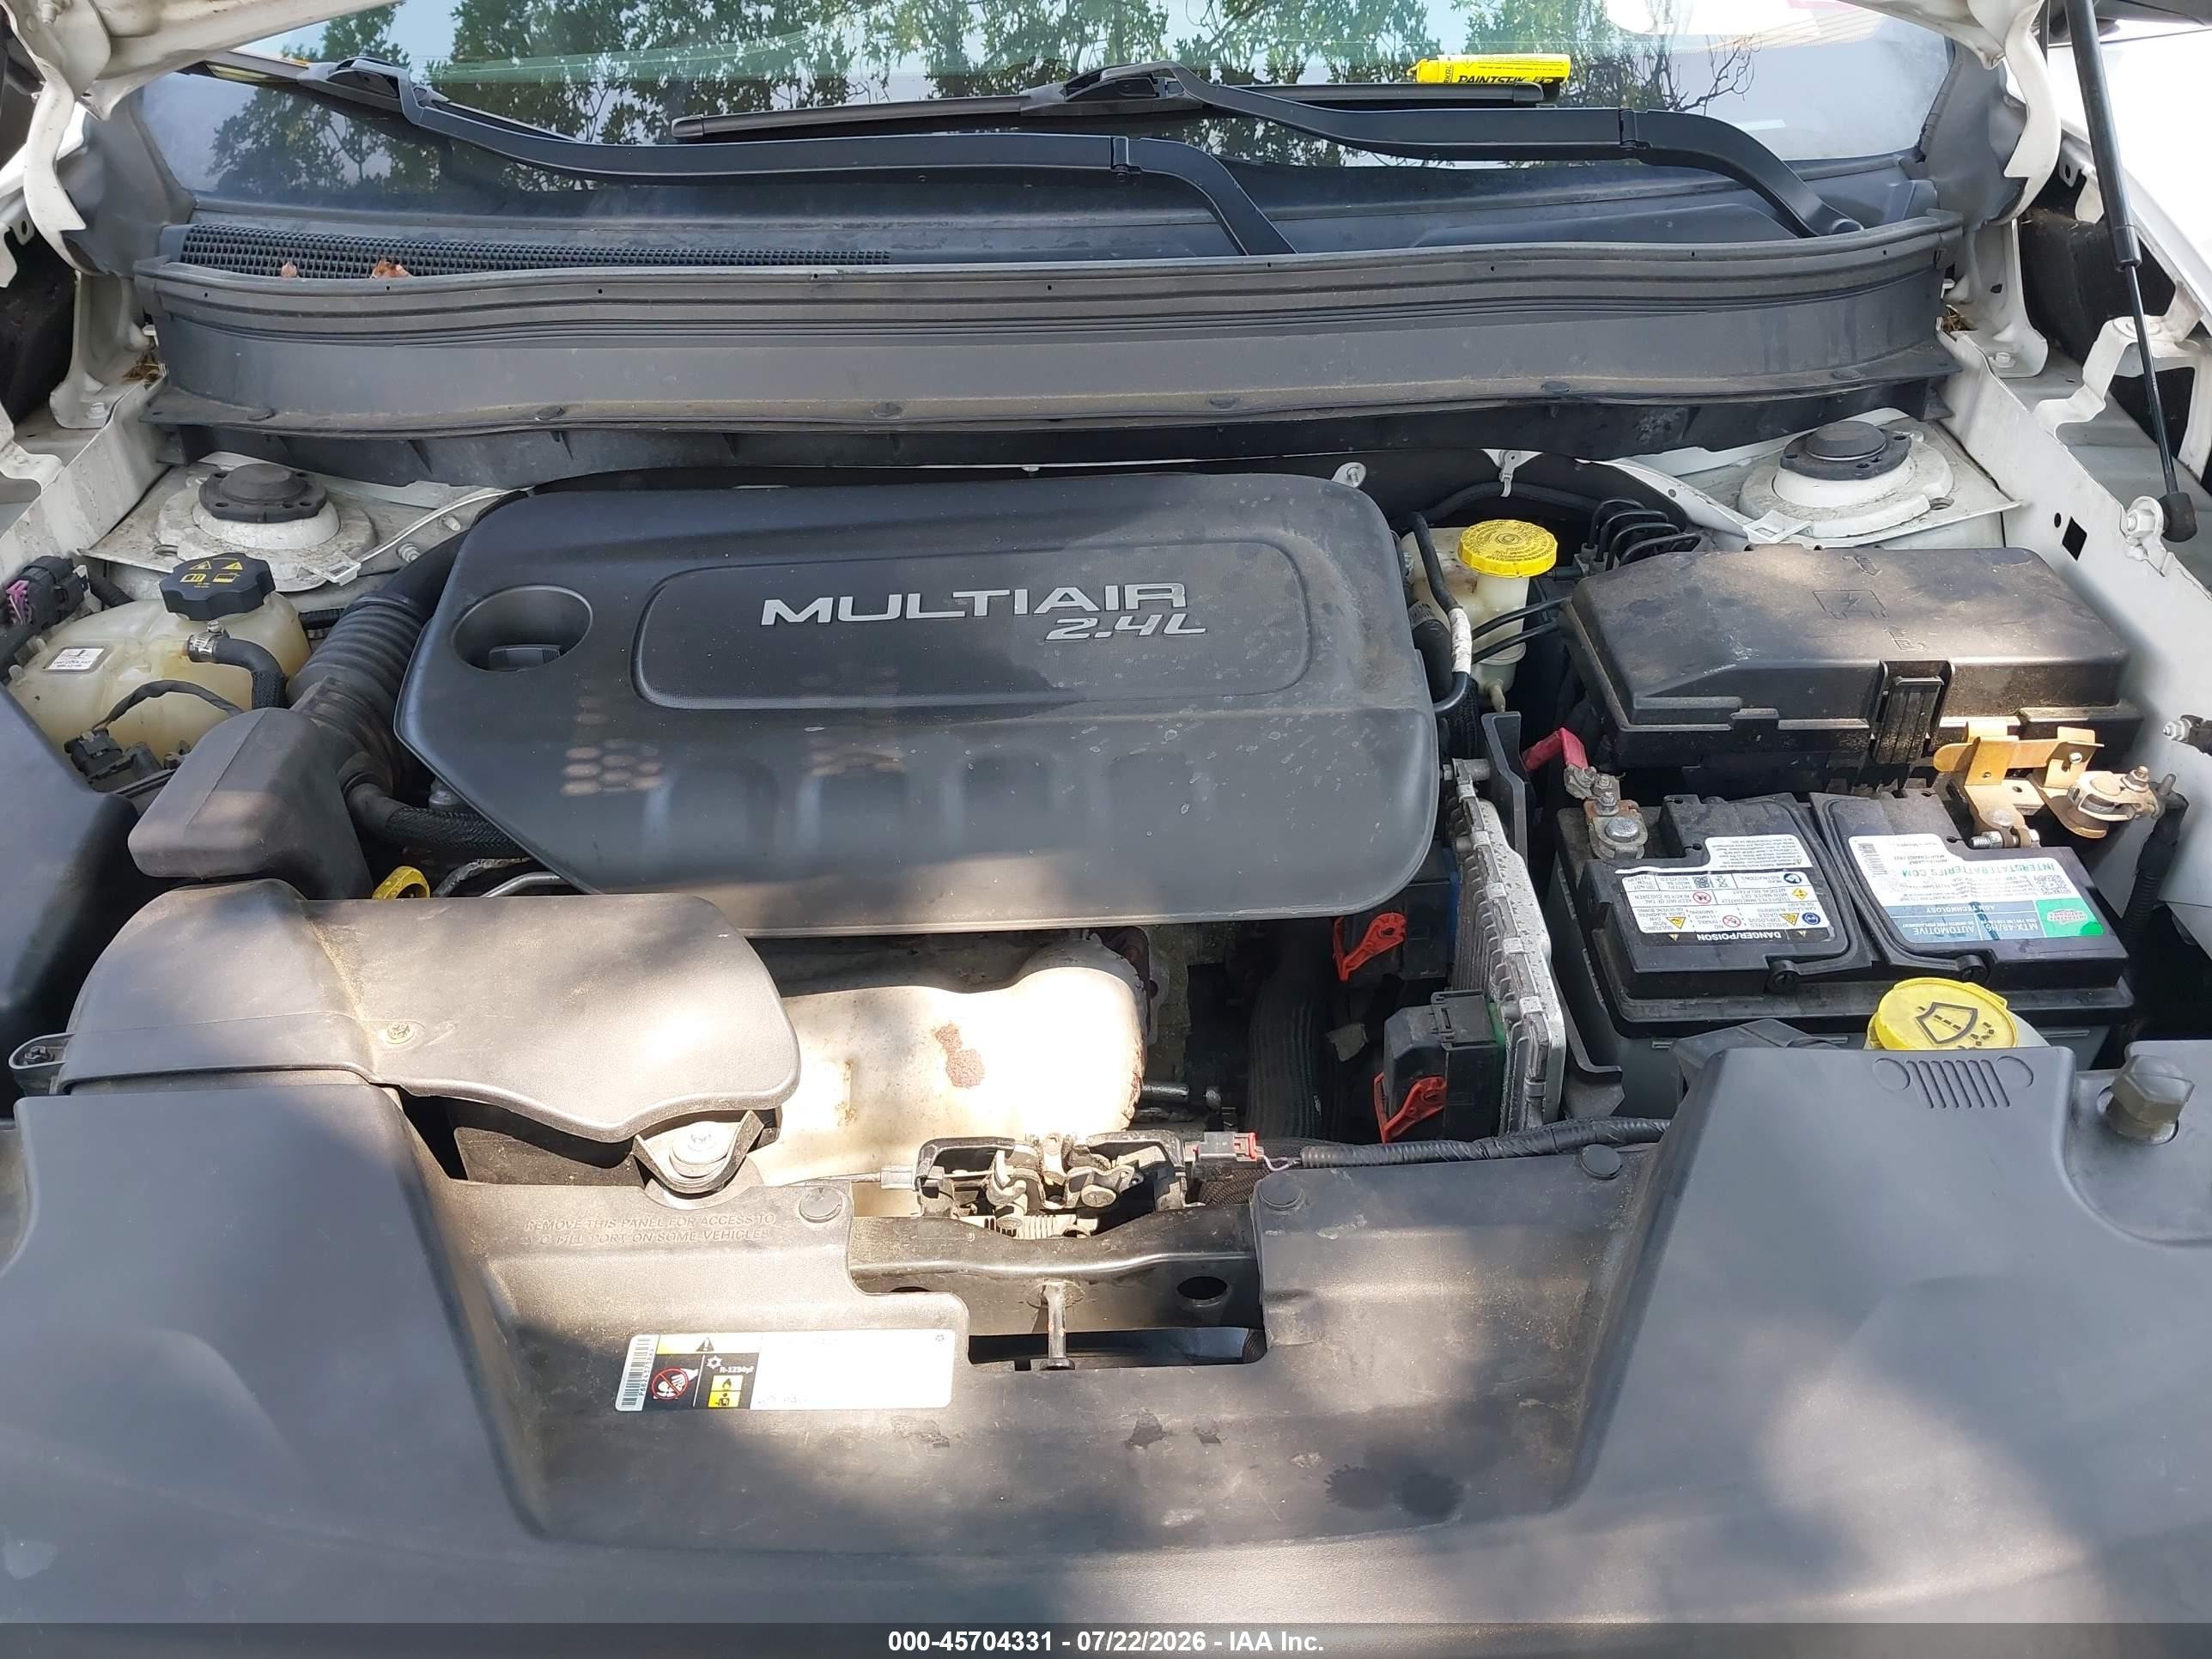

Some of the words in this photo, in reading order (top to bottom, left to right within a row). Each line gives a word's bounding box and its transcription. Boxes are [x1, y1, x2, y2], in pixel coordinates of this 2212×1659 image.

[761, 583, 1188, 626] MULTIAIR
[1045, 613, 1206, 641] 2.4L
[1696, 931, 1782, 941] DANGER/POISON
[1912, 926, 1974, 934] AUTOMOTIVE
[526, 1219, 582, 1231] REMOVE
[587, 1218, 617, 1229] THIS
[621, 1218, 666, 1229] PANEL
[669, 1217, 696, 1227] FOR
[700, 1215, 753, 1226] ACCESS
[757, 1213, 775, 1224] TO
[633, 1231, 653, 1243] ON
[658, 1231, 696, 1242] SOME
